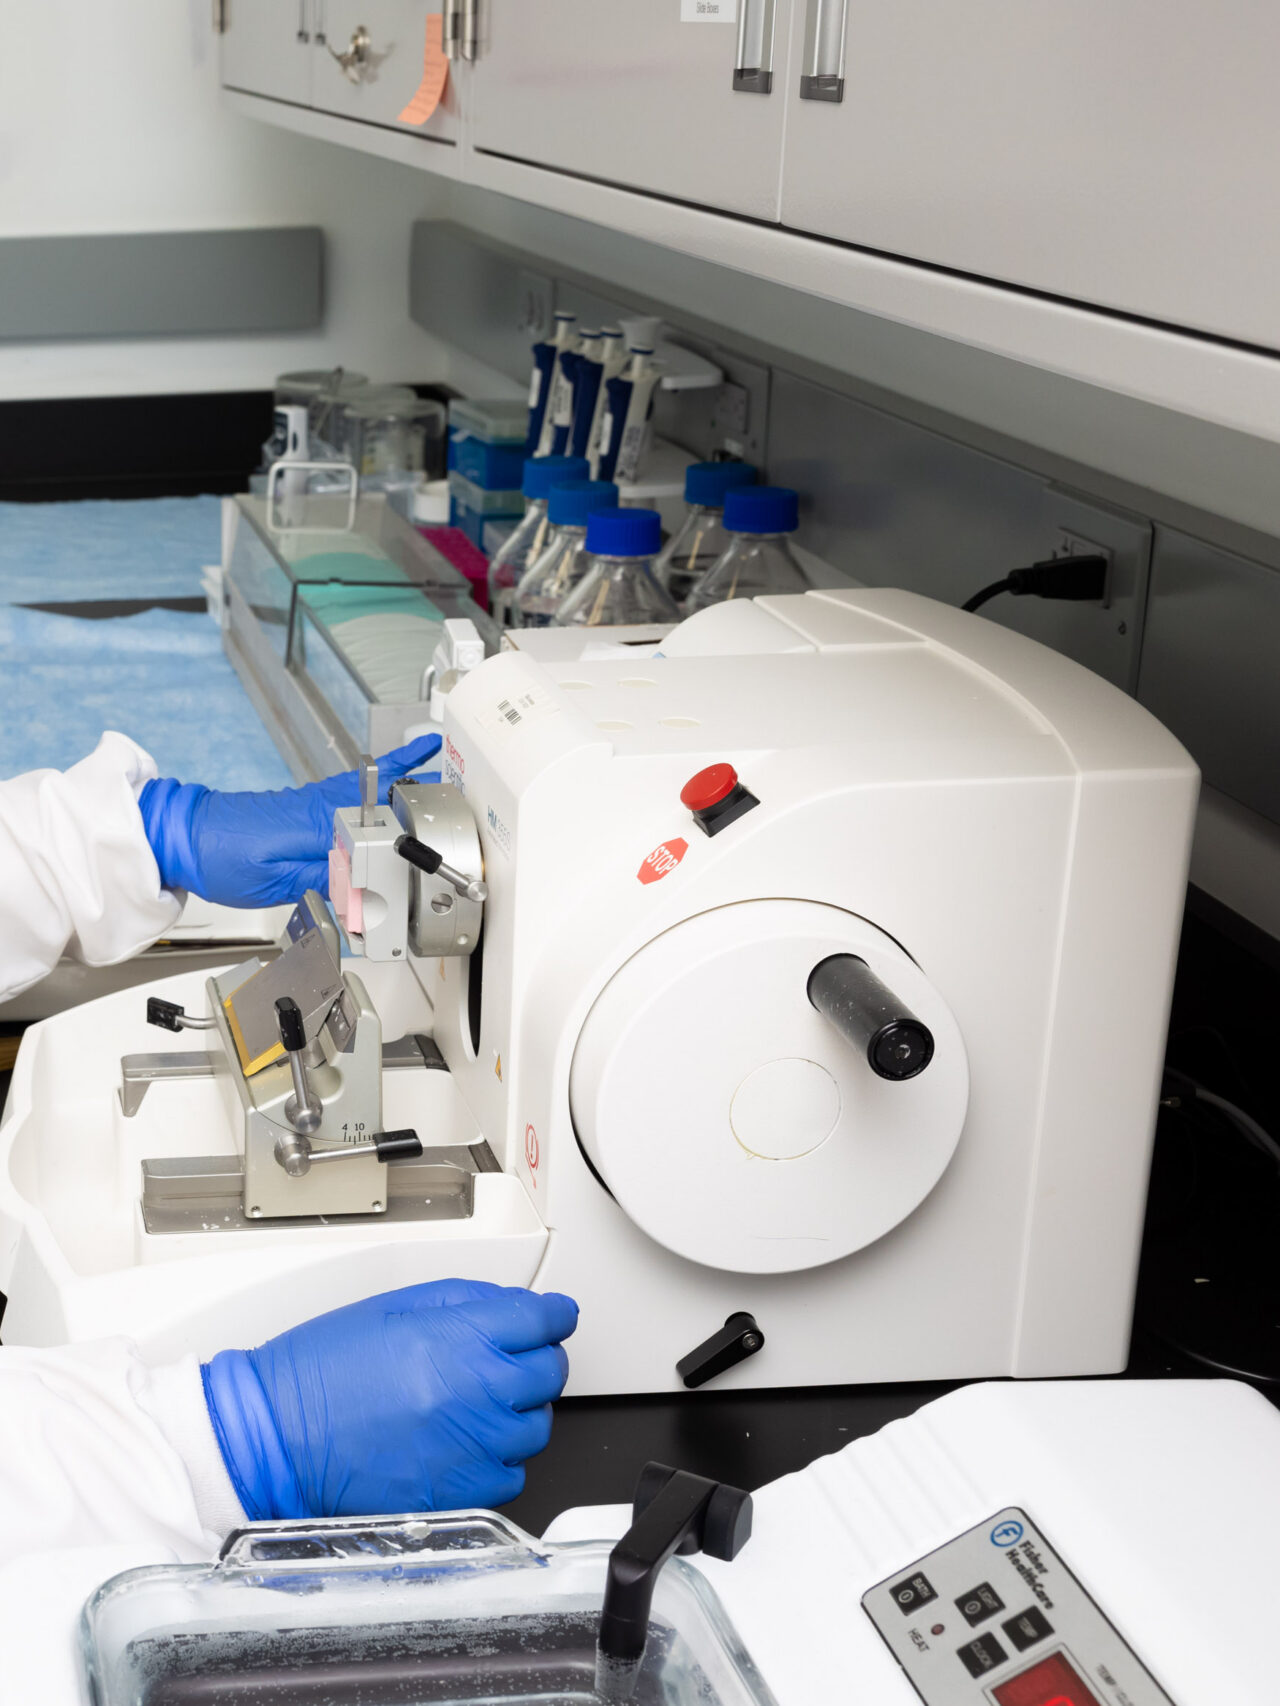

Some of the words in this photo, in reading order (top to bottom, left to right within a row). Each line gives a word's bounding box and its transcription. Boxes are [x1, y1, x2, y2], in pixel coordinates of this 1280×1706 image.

[647, 846, 679, 875] STOP
[341, 1123, 348, 1131] 4
[354, 1122, 365, 1131] 10
[1019, 1540, 1049, 1574] Fisher
[912, 1577, 932, 1599] BATH
[1005, 1548, 1054, 1610] HealthCare
[908, 1628, 930, 1653] HEAT
